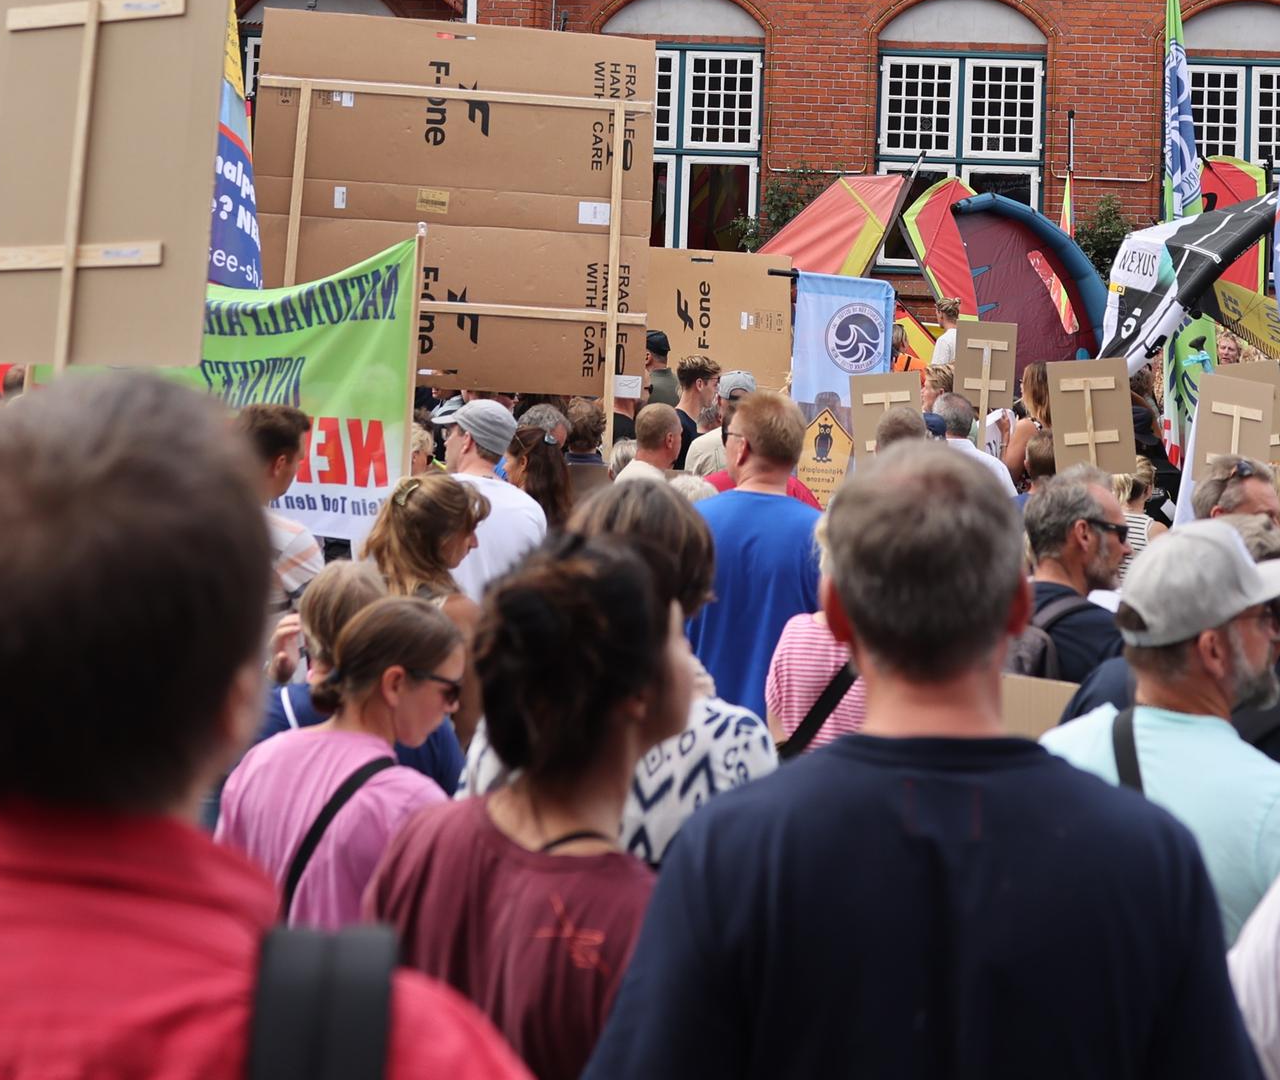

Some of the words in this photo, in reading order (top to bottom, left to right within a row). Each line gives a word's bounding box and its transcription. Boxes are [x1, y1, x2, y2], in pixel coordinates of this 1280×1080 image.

[608, 62, 621, 135] HANLE
[625, 63, 638, 140] FRAILE
[590, 121, 604, 171] CARE
[585, 262, 599, 312] WITH
[1119, 251, 1157, 278] NEXUS
[698, 280, 711, 350] F-one
[581, 325, 596, 377] CARE
